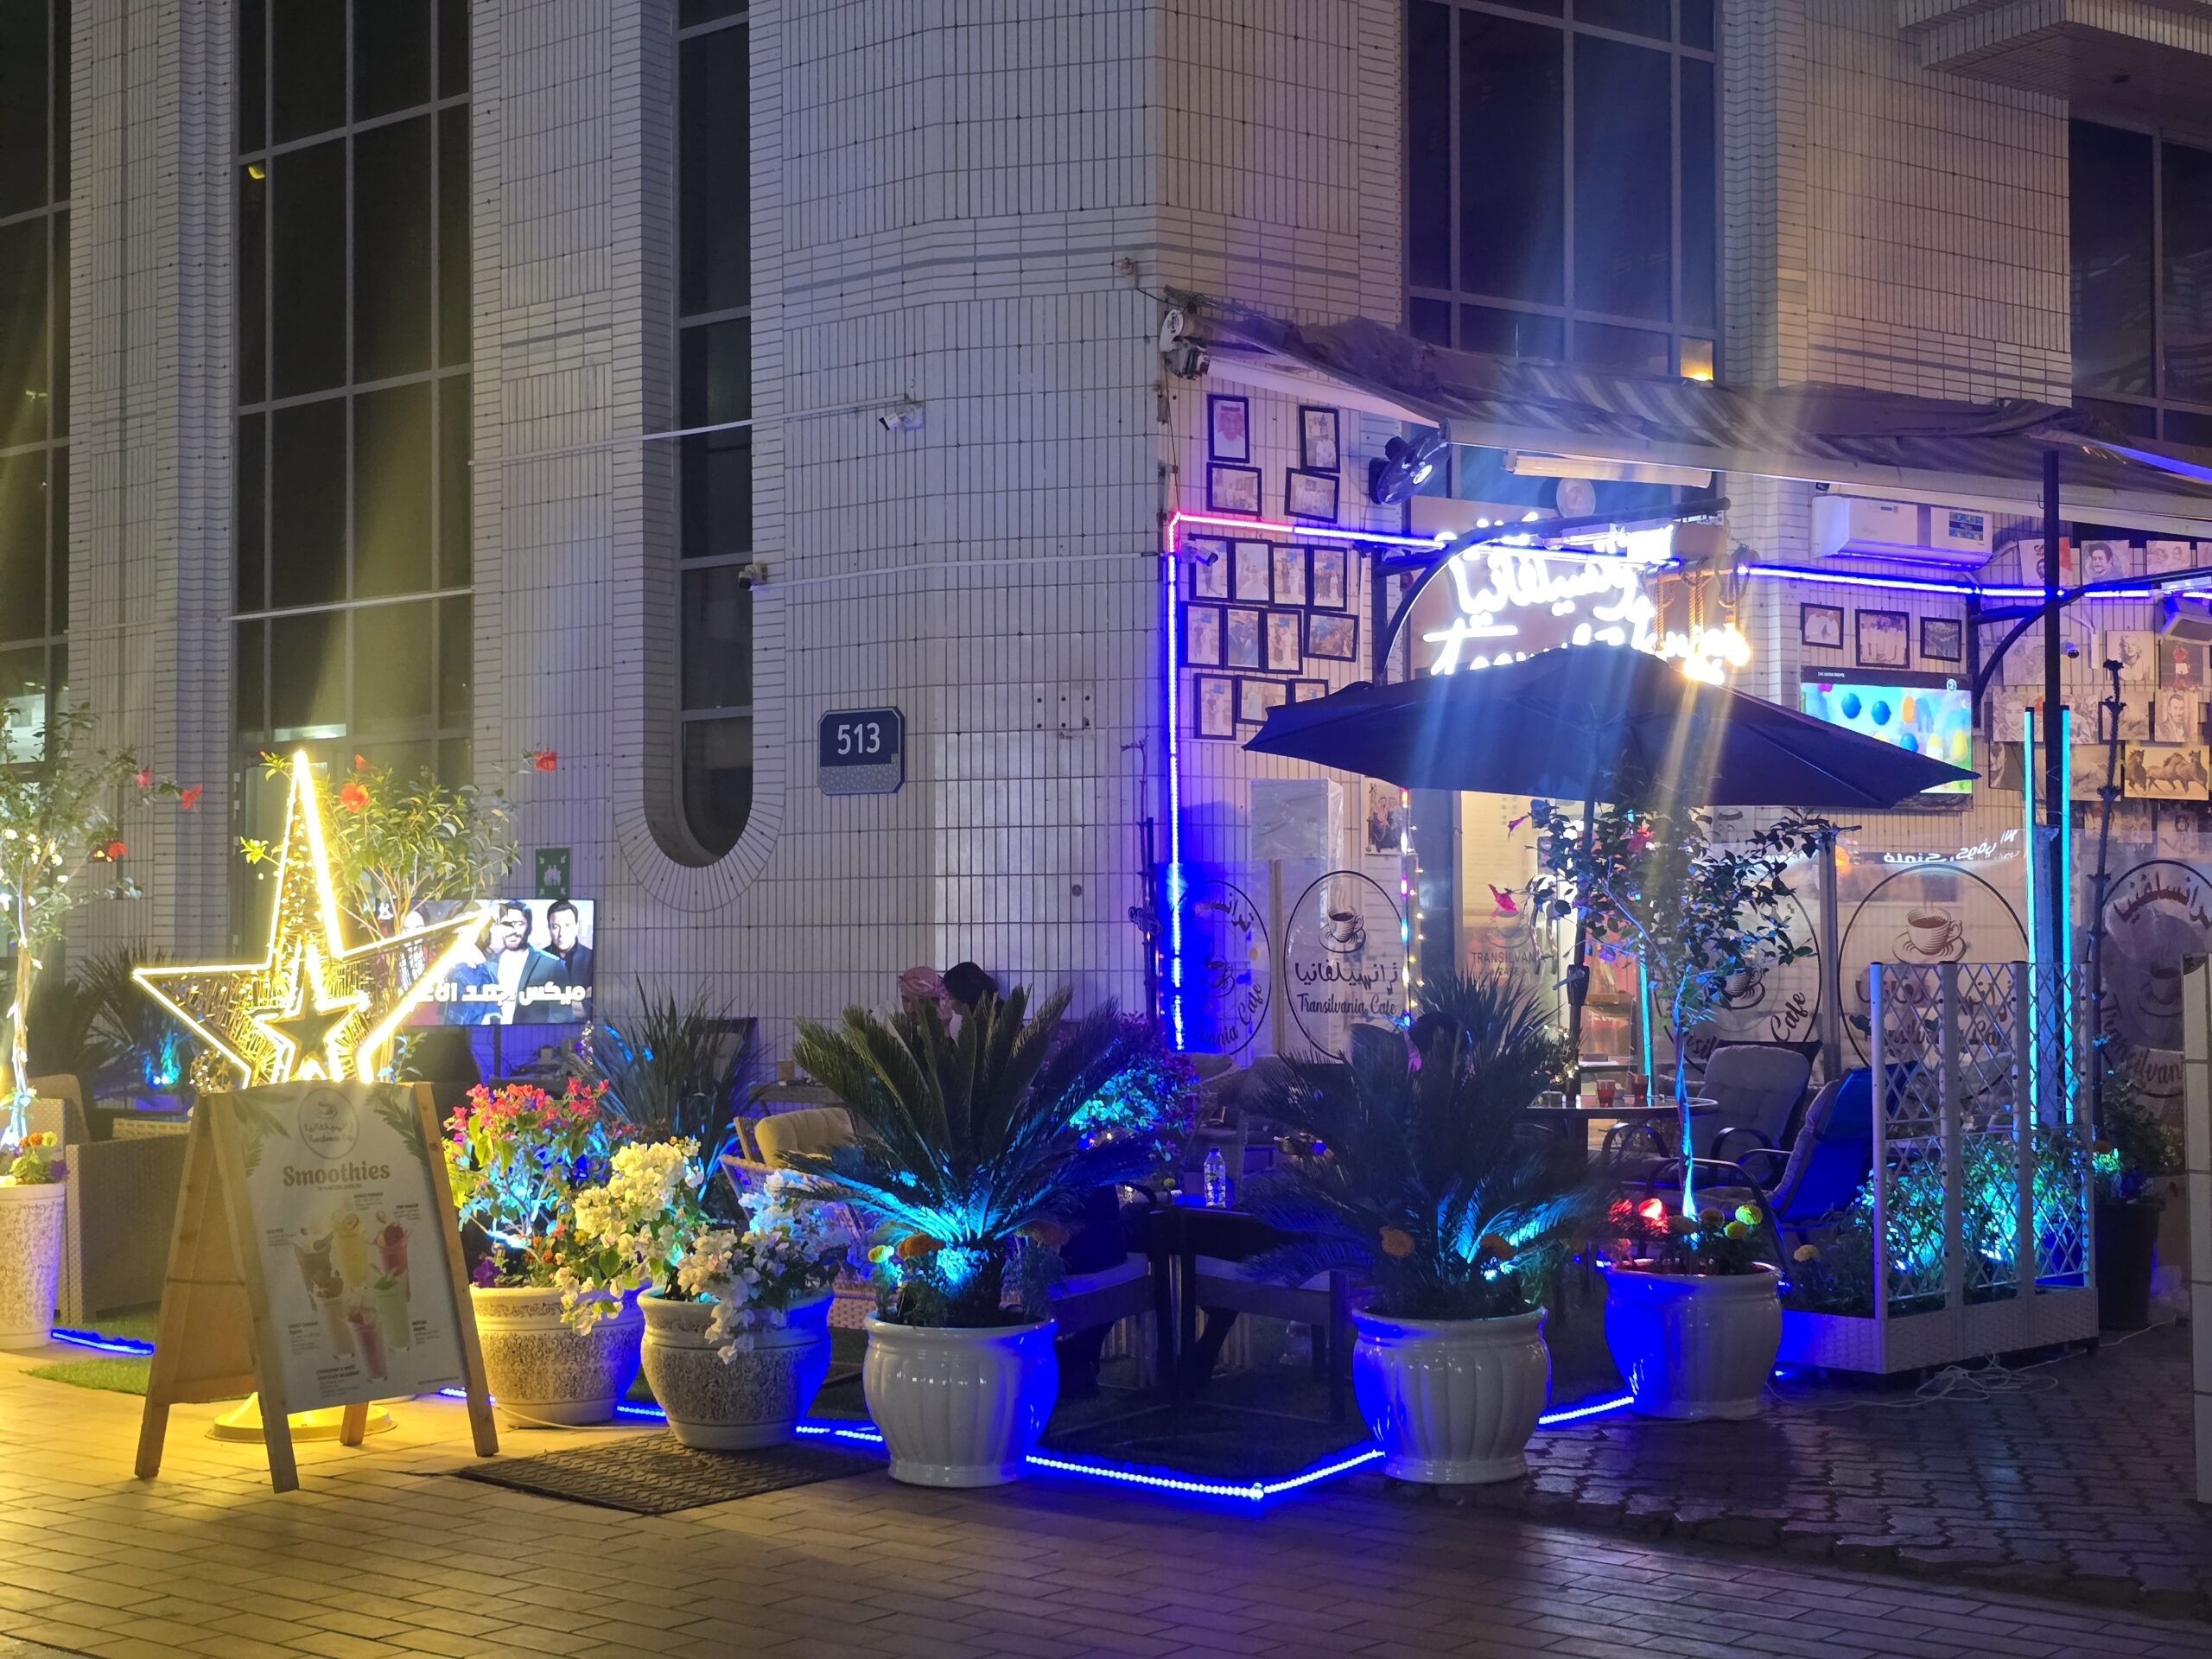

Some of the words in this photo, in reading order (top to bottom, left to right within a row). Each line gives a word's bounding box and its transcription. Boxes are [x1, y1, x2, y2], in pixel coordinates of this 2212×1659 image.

[836, 721, 880, 755] 513
[519, 981, 586, 1006] ميكس
[1237, 982, 1263, 1027] Cafe
[1296, 993, 1366, 1014] Transilvania
[1770, 991, 1809, 1042] Cafe
[283, 1160, 391, 1186] Smoothies
